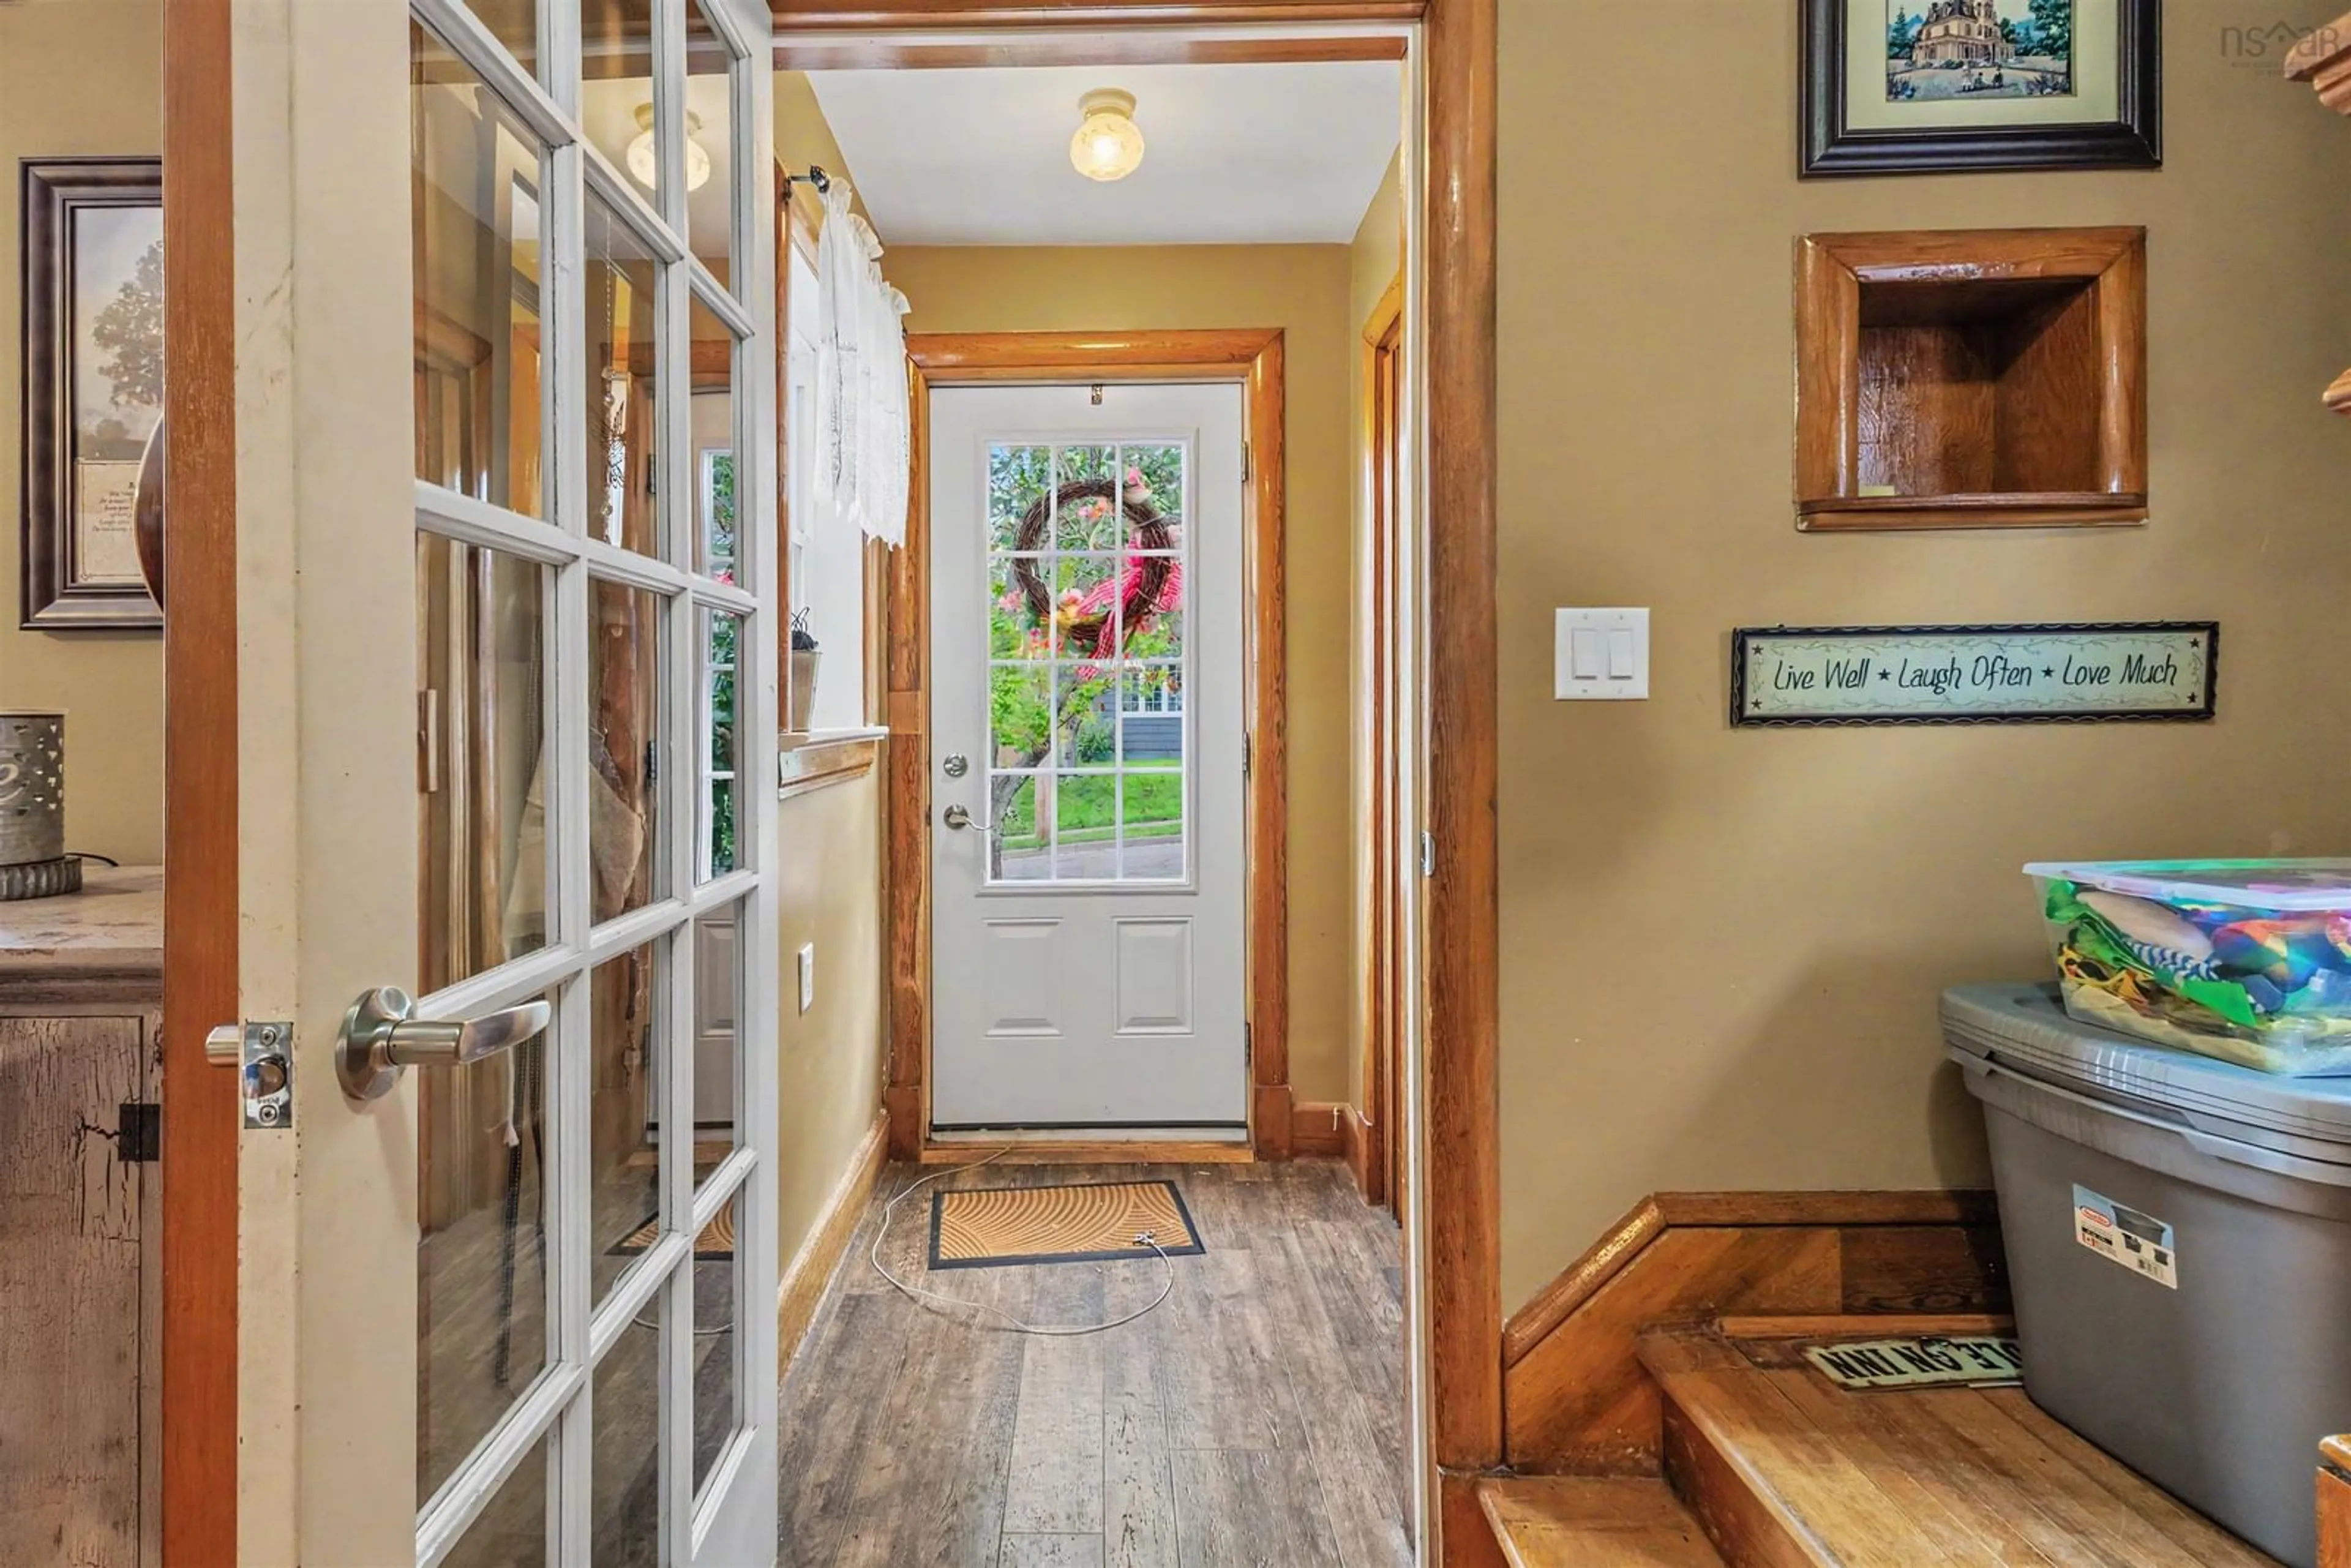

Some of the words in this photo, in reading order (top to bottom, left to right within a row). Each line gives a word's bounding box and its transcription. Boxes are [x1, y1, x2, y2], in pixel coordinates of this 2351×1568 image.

[1774, 659, 1815, 690] Live
[1825, 658, 1870, 689] Well
[1899, 657, 1961, 695] Laugh
[1971, 655, 2032, 691] Often
[2062, 654, 2111, 686] Love
[2119, 653, 2177, 686] Much
